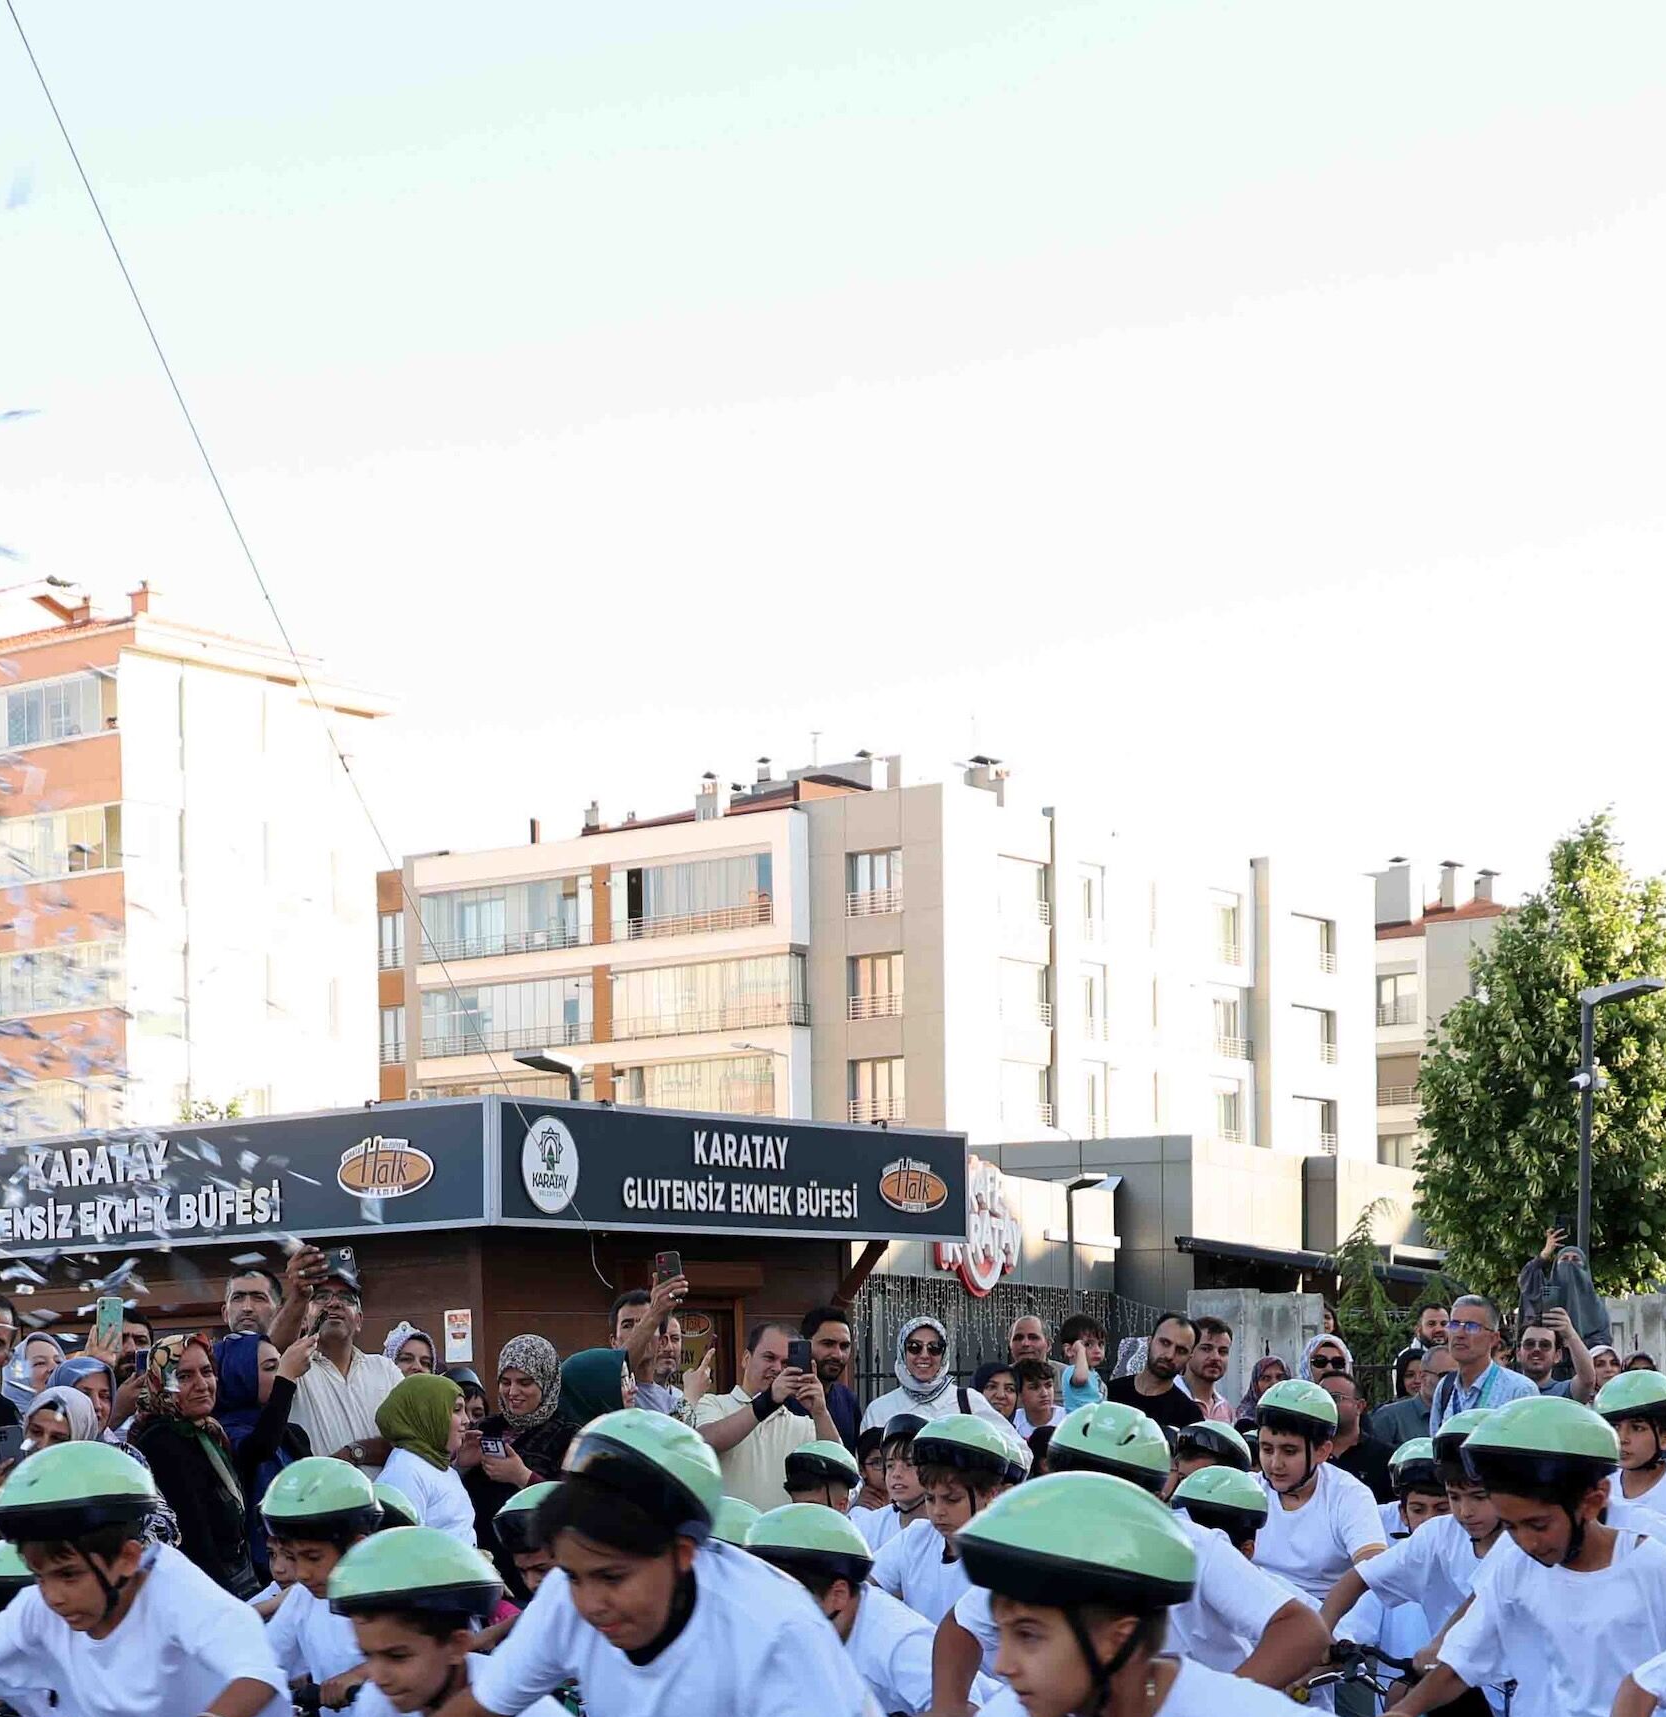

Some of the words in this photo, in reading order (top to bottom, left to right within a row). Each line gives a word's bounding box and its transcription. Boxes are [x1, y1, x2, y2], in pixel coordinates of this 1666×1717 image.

[28, 1139, 169, 1190] KARATAY
[361, 1140, 407, 1184] Halk
[693, 1130, 789, 1170] KARATAY
[532, 1171, 569, 1189] KARATAY
[623, 1175, 726, 1213] GLUTENSİZ
[731, 1182, 792, 1217] EKMEK
[796, 1180, 859, 1220] BÜFESİ
[896, 1160, 930, 1200] Halk
[80, 1195, 171, 1236] EKMEK
[179, 1179, 281, 1230] BÜFESİ
